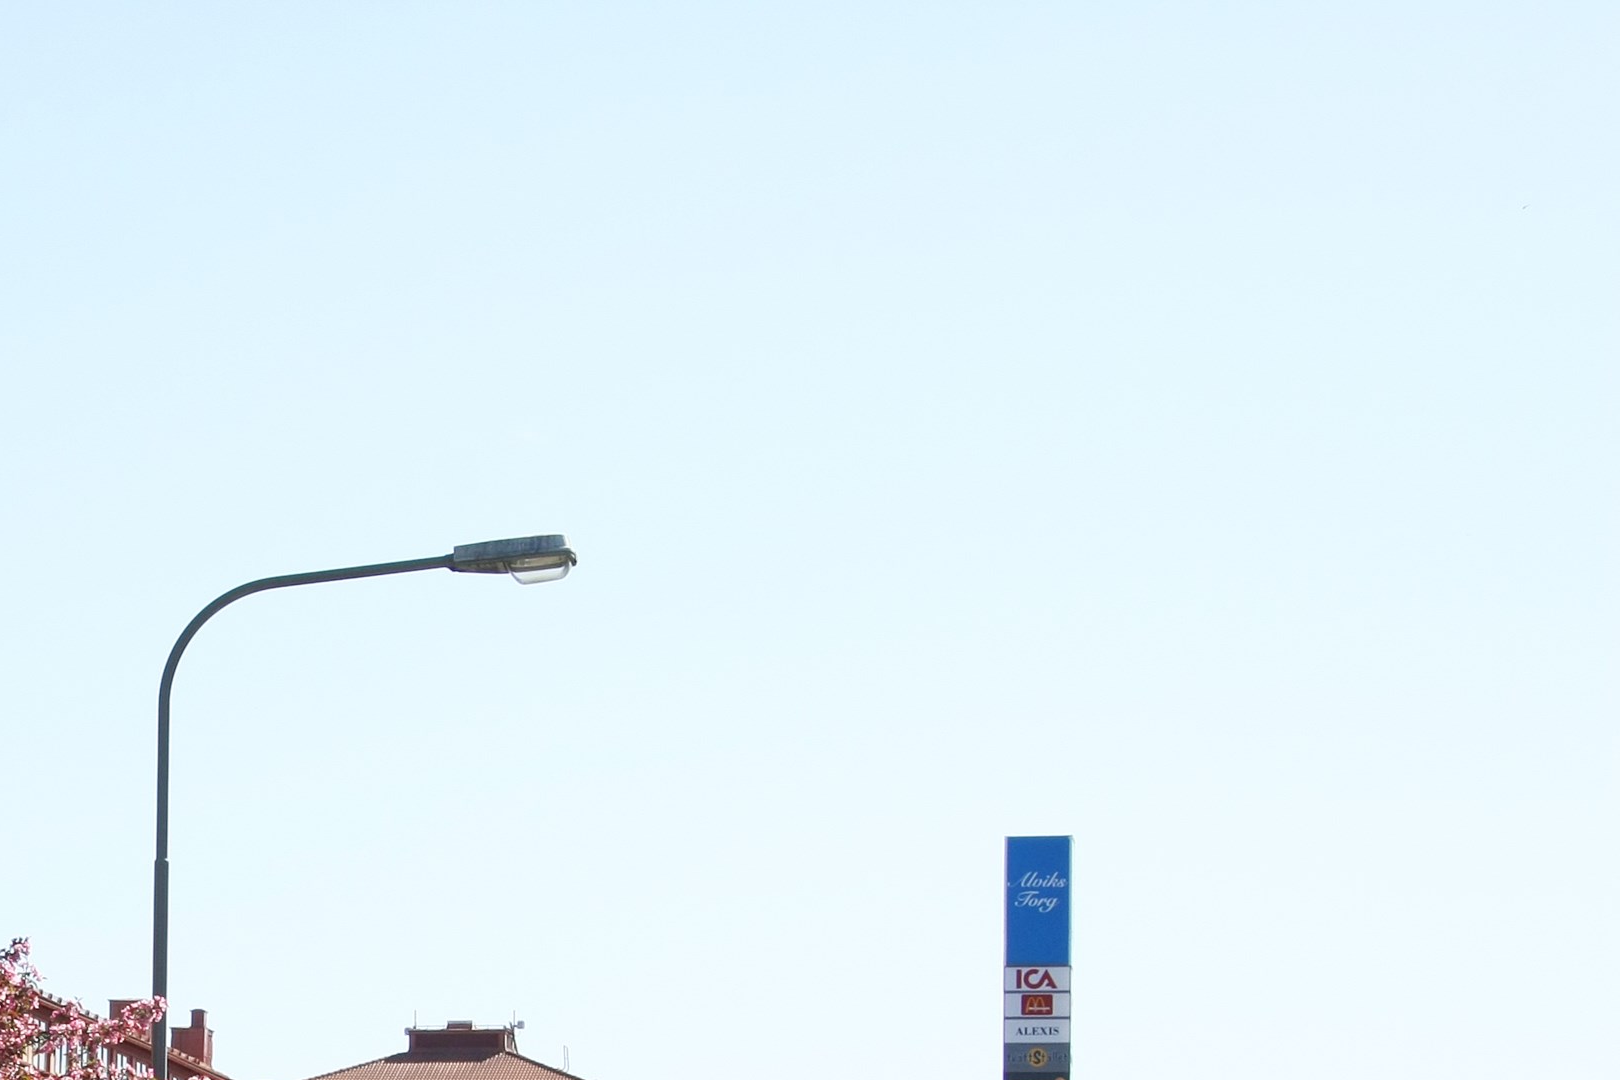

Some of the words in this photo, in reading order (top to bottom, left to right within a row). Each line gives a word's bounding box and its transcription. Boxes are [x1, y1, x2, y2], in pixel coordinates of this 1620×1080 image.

[1007, 872, 1067, 888] Alviks
[1014, 890, 1059, 913] Torg
[1016, 969, 1057, 989] ICA
[1016, 1026, 1060, 1036] ALEXIS
